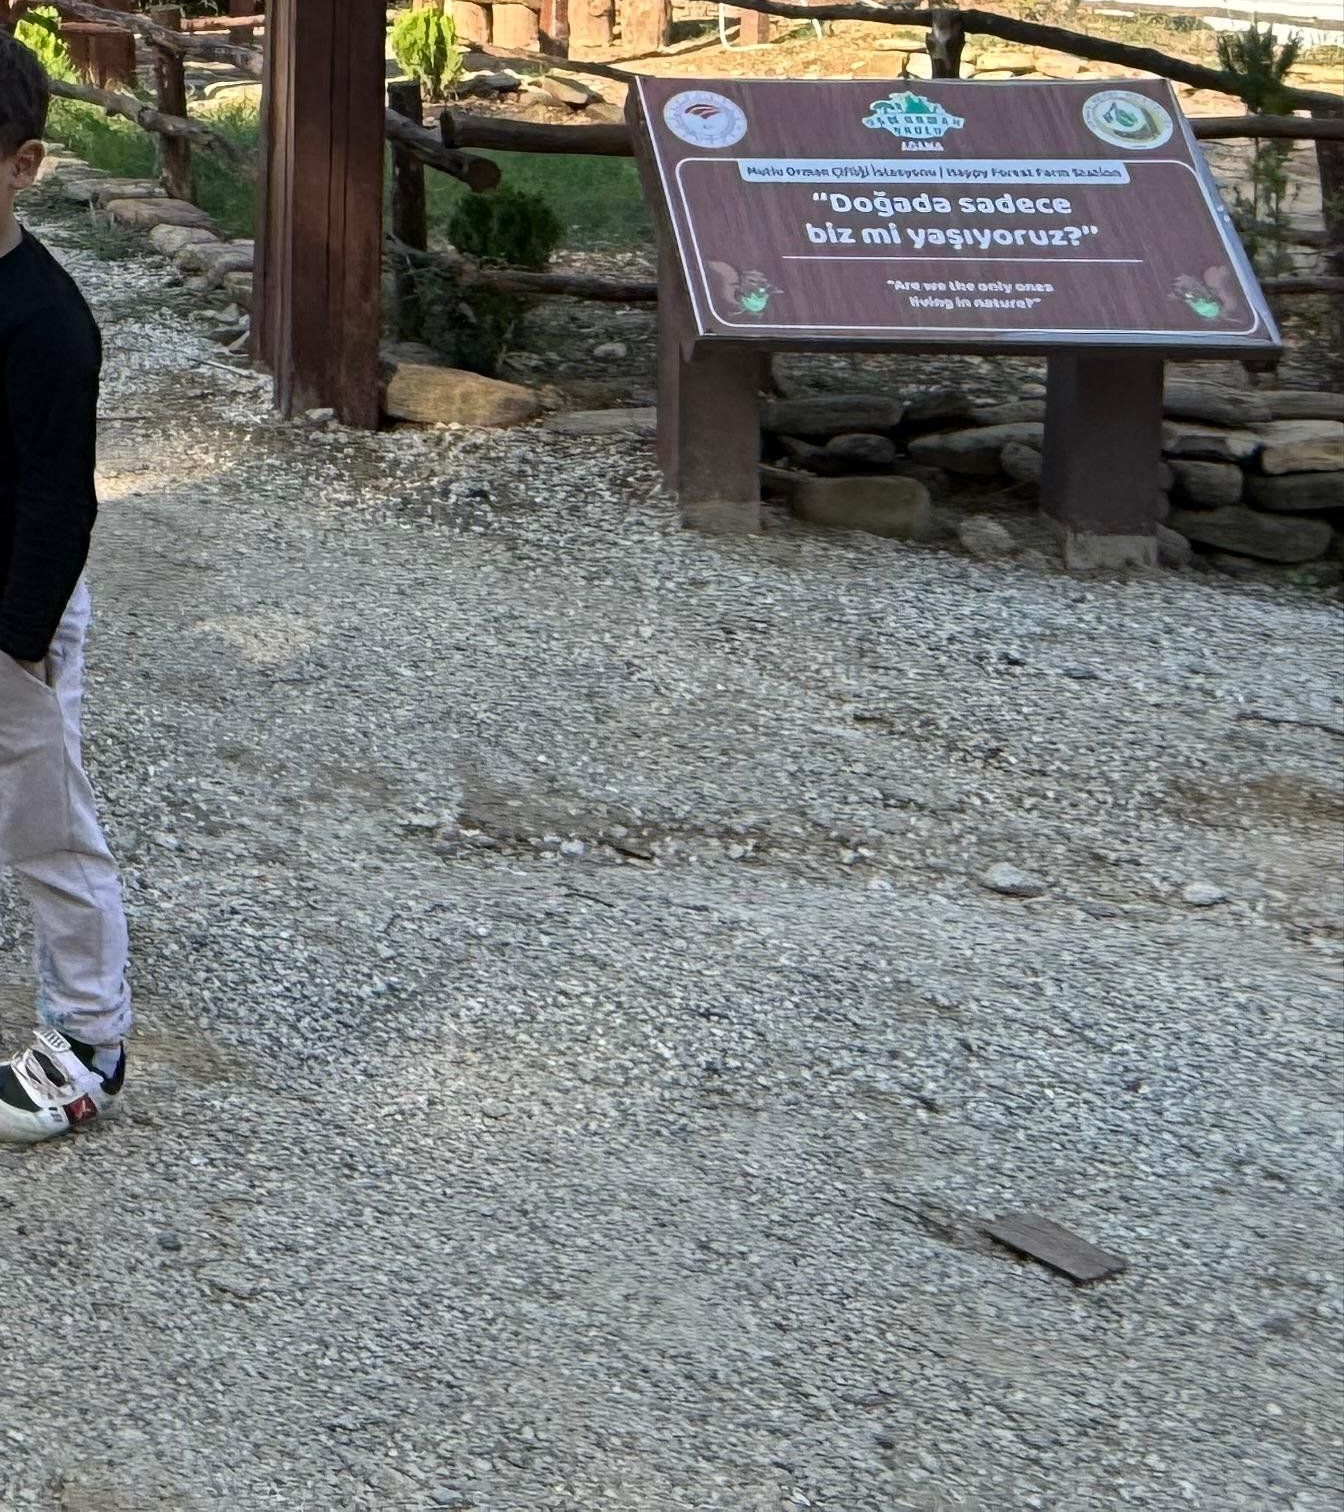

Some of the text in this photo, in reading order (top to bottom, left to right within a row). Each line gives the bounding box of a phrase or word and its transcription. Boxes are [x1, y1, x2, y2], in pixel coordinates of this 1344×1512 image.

[958, 193, 1072, 215] sadece
[805, 222, 856, 244] biz
[861, 222, 902, 245] mi
